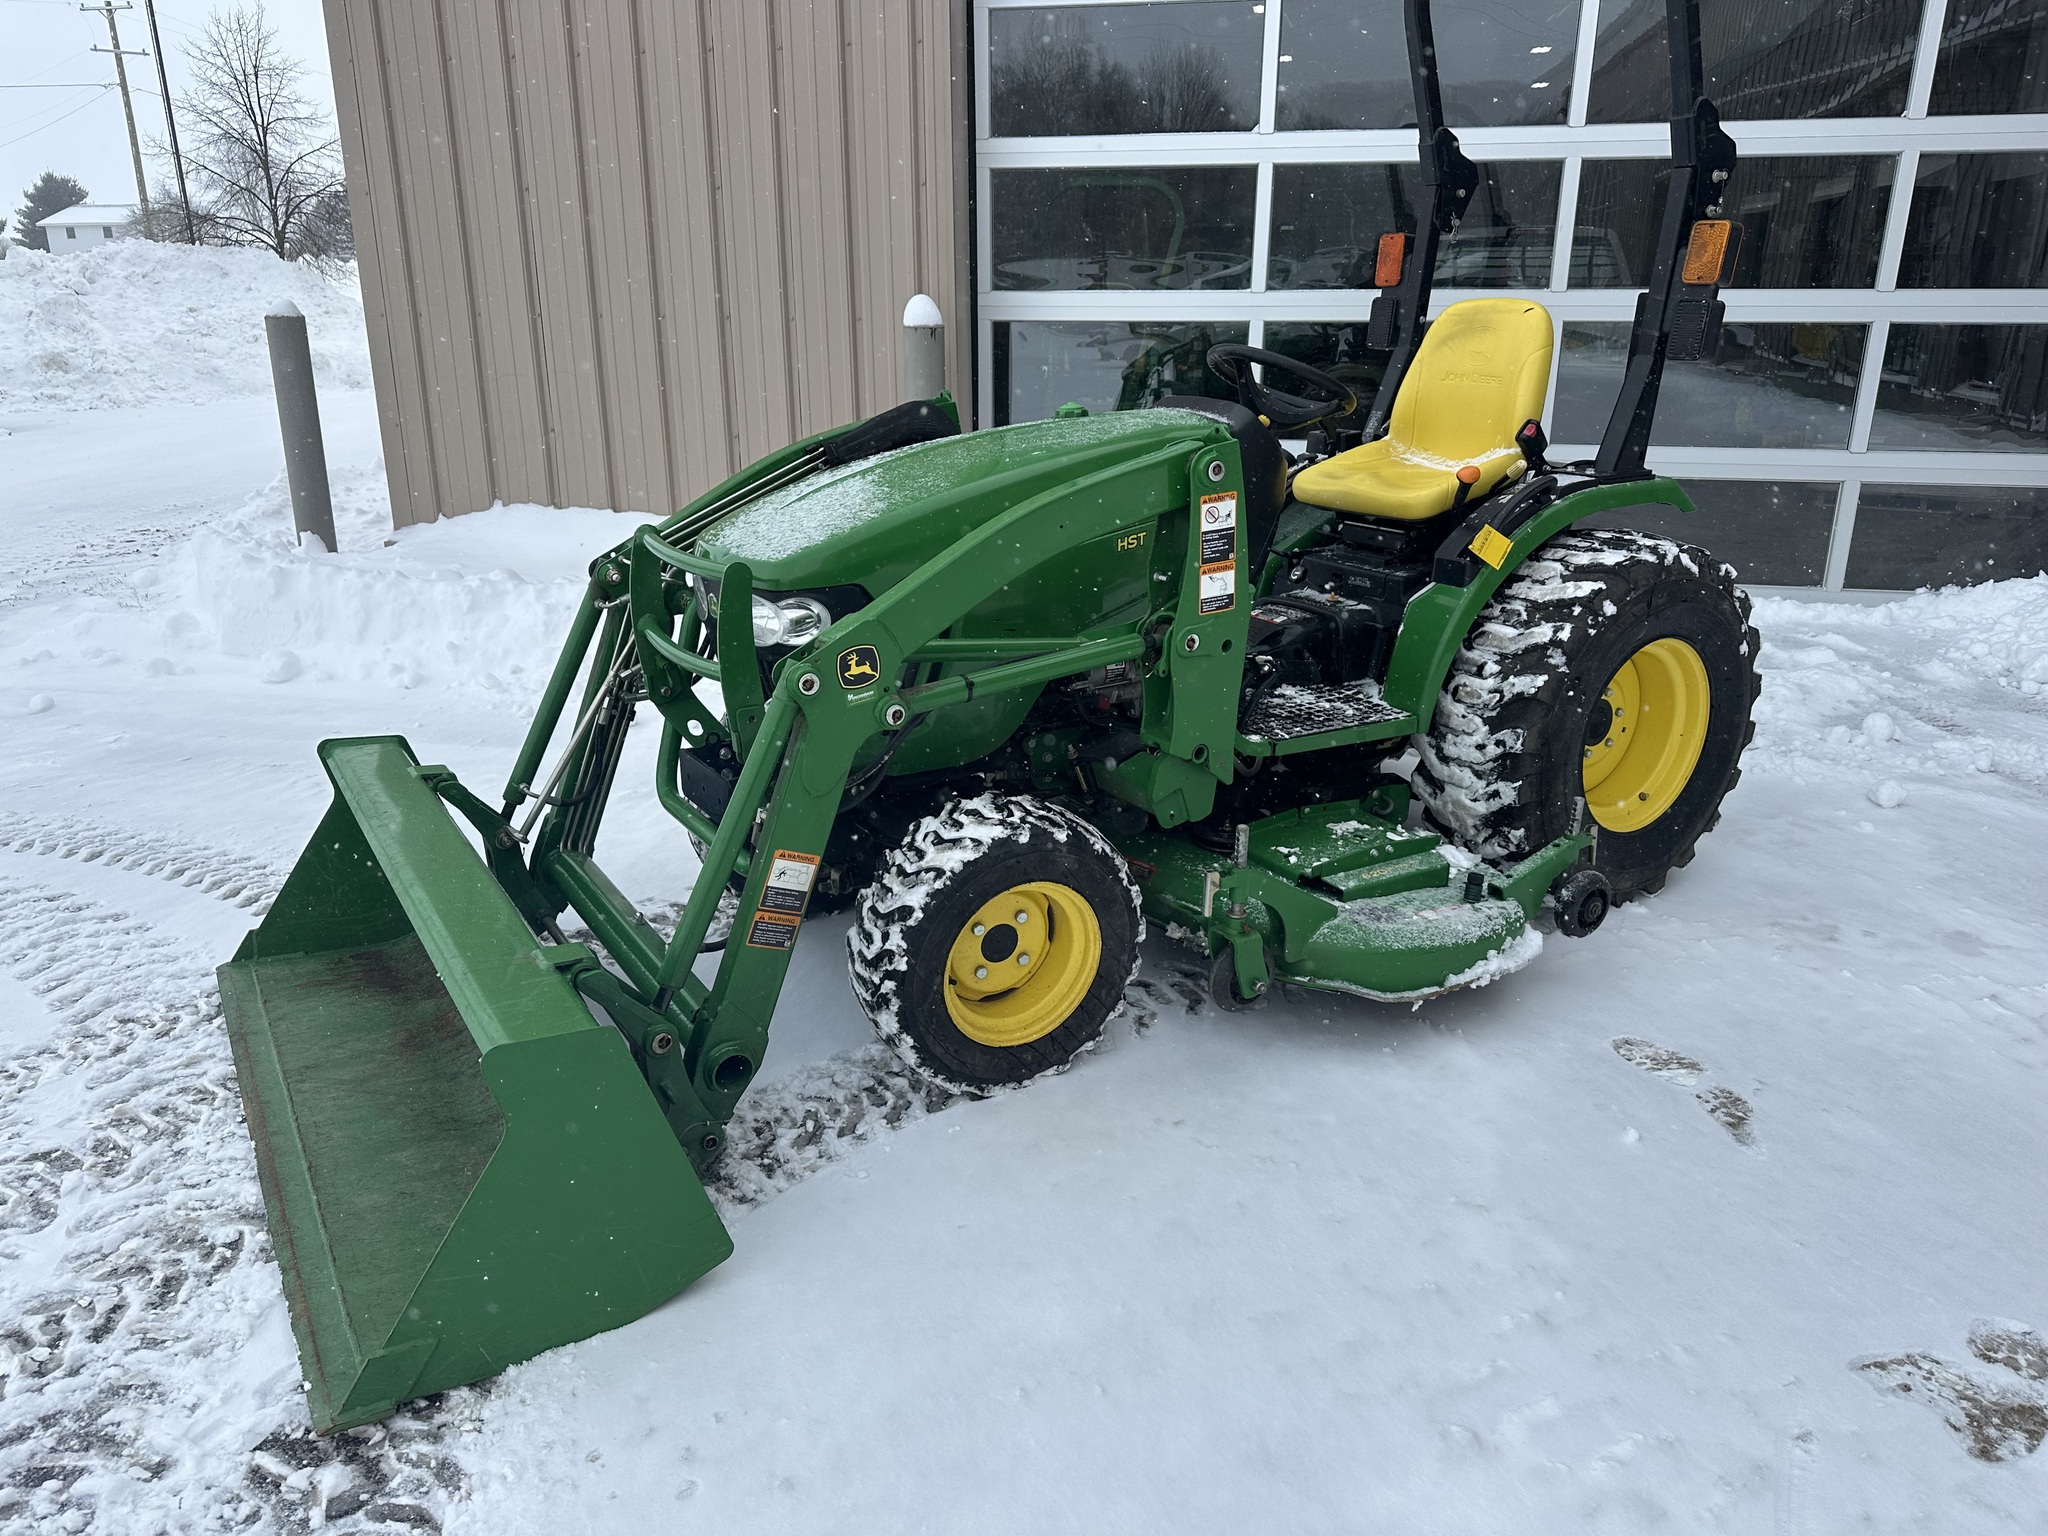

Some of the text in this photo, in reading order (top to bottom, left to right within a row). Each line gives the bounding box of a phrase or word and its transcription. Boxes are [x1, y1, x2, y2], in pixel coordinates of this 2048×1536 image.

[1441, 371, 1503, 385] JOHN DEERE
[1117, 531, 1147, 552] HST
[1207, 563, 1234, 573] WARNING
[787, 852, 815, 862] WARNING
[767, 915, 795, 924] WARNING
